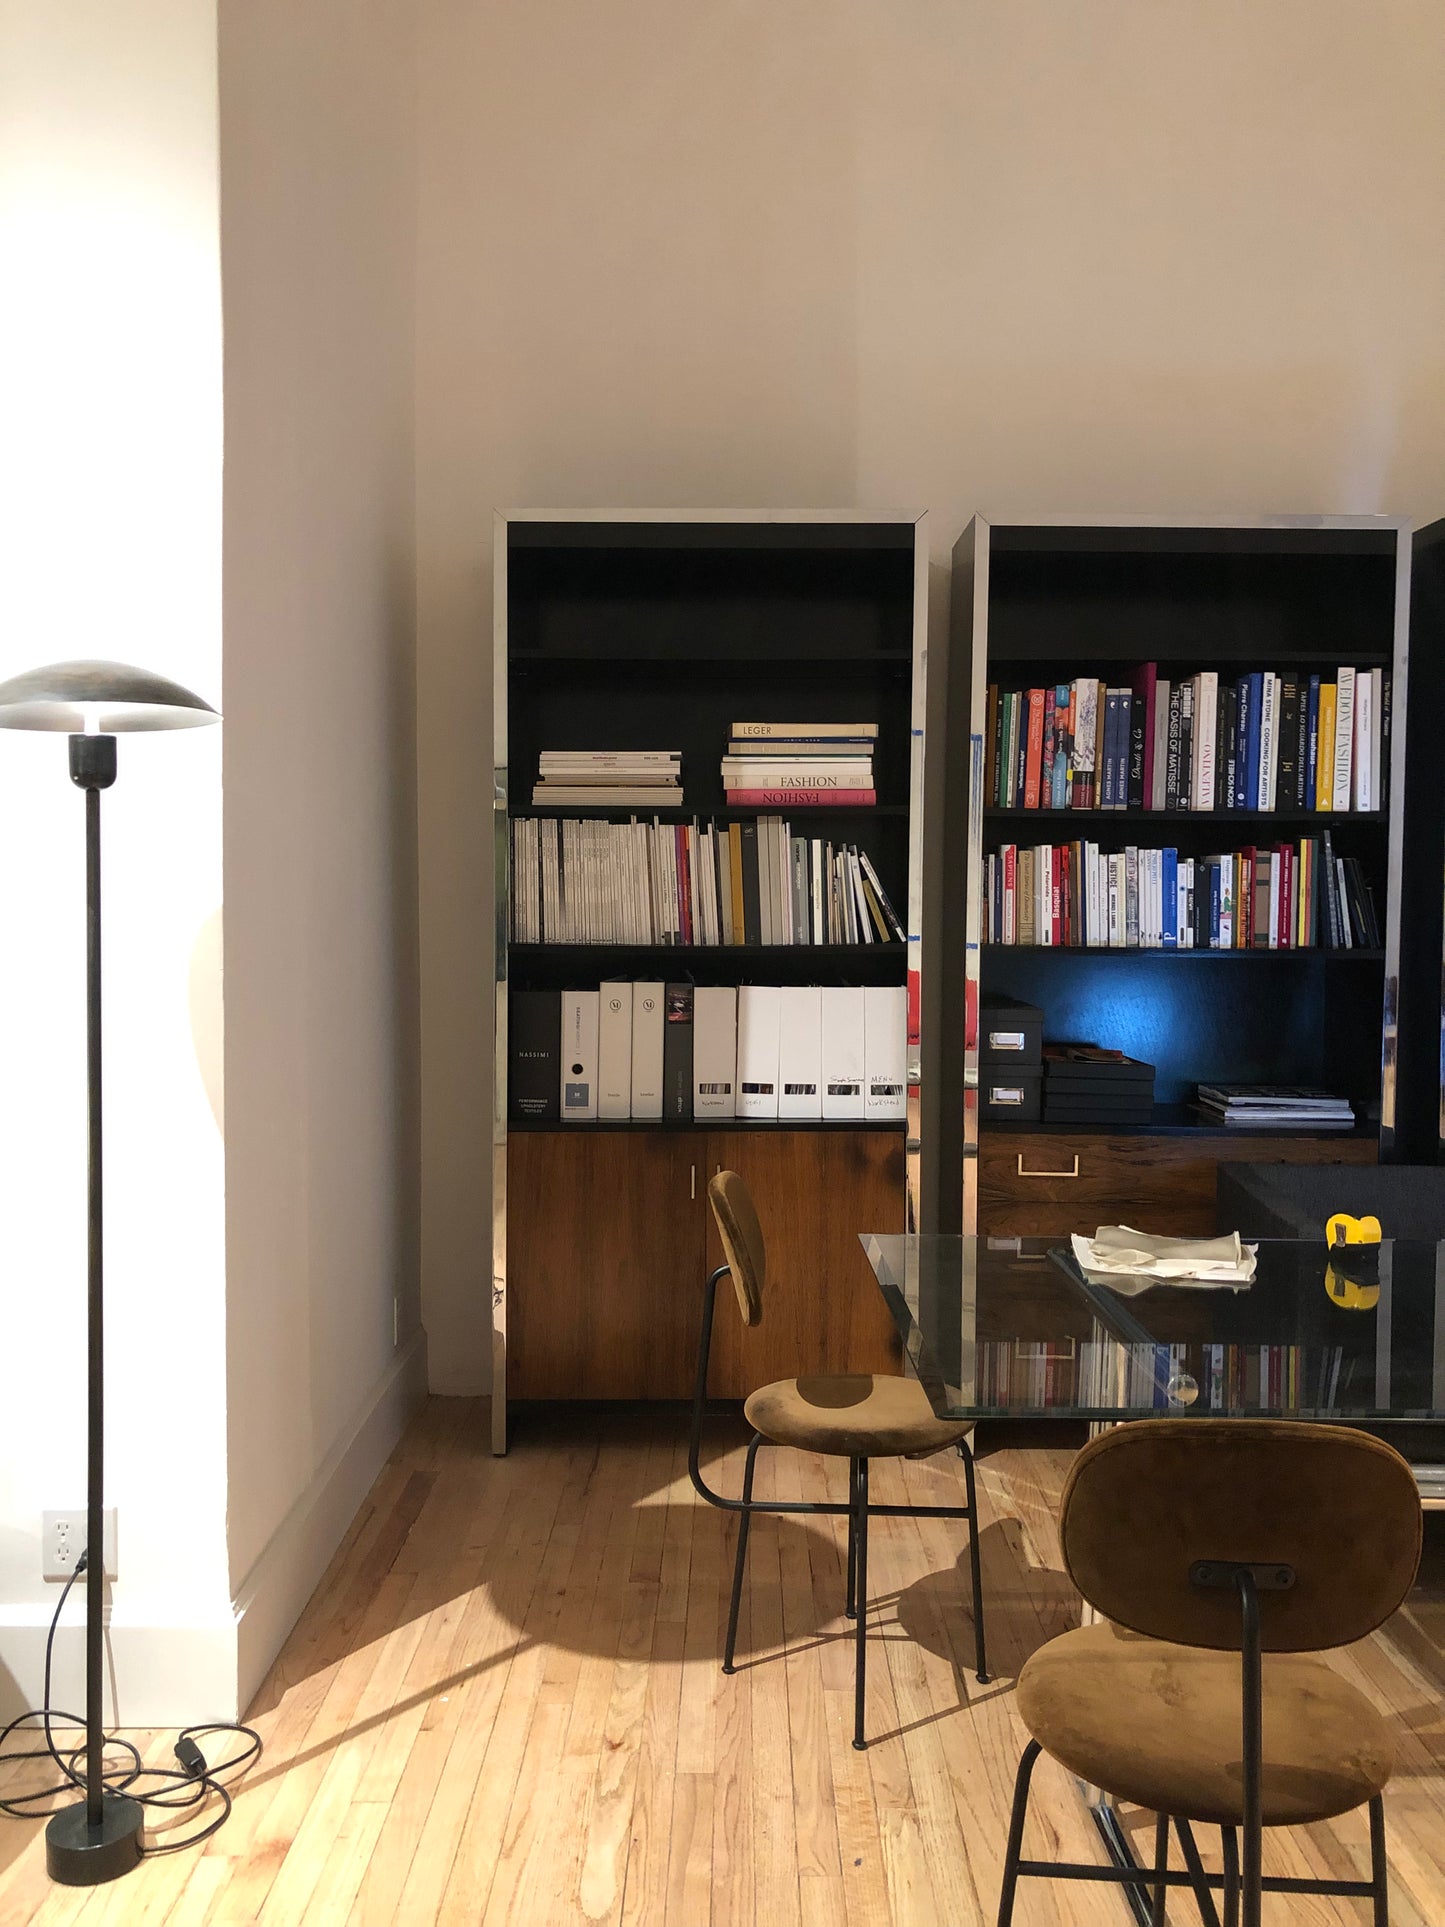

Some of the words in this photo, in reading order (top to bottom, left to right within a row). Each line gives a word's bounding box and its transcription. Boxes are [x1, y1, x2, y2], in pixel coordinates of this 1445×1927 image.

[1171, 691, 1179, 708] THE
[1340, 674, 1352, 722] AVEDON
[1170, 710, 1178, 738] OASIS
[1300, 715, 1306, 723] LO
[1132, 729, 1142, 739] Co
[1169, 740, 1177, 752] OF
[1131, 752, 1142, 778] Death
[1337, 734, 1348, 791] FASHION
[781, 776, 837, 787] FASHION
[1168, 754, 1176, 793] MATISSE
[1202, 744, 1212, 804] VALENTINO
[763, 793, 819, 803] FASHION
[1128, 870, 1134, 882] ME
